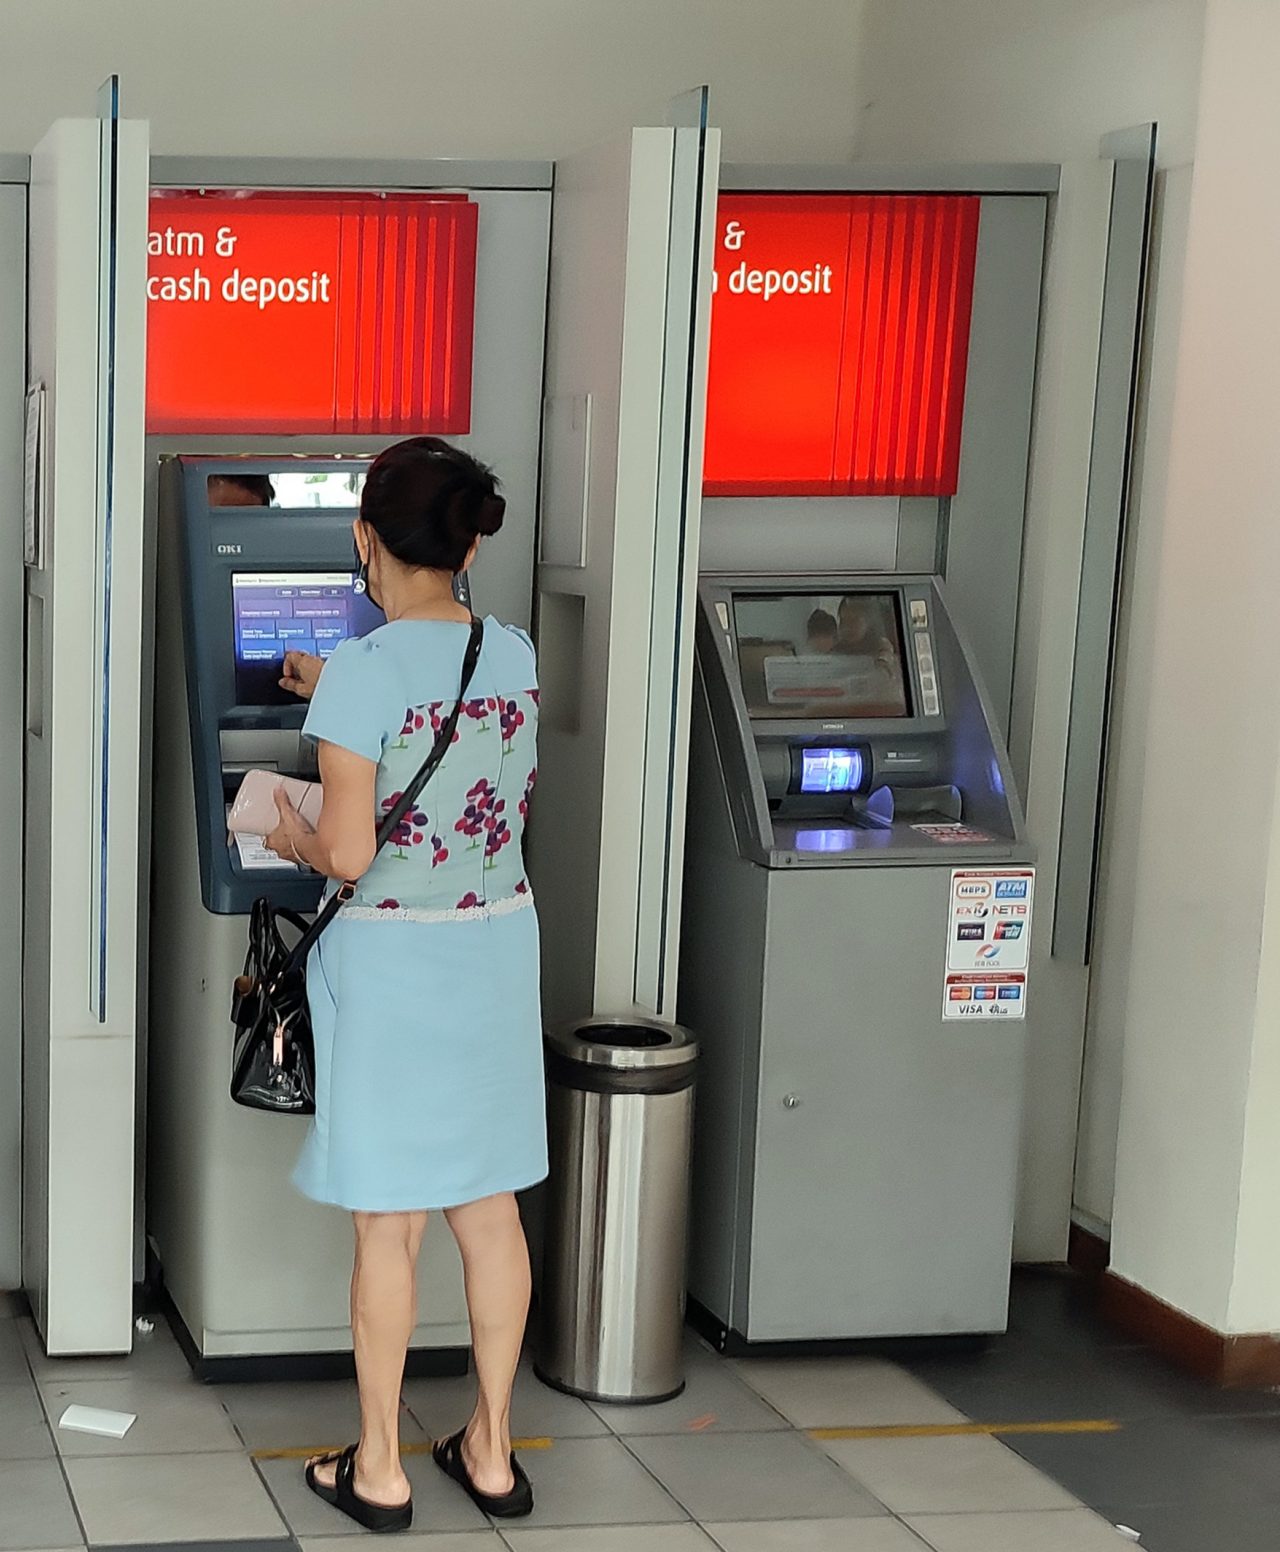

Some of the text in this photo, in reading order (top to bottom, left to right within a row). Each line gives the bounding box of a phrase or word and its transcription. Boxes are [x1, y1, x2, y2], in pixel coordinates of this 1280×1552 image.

[148, 227, 237, 256] atm &
[724, 221, 745, 250] &
[146, 269, 329, 309] cash deposit
[729, 262, 832, 301] deposit
[217, 545, 242, 553] OKI
[998, 882, 1026, 890] ATM
[992, 904, 1027, 915] NETS
[959, 1005, 983, 1014] VISA
